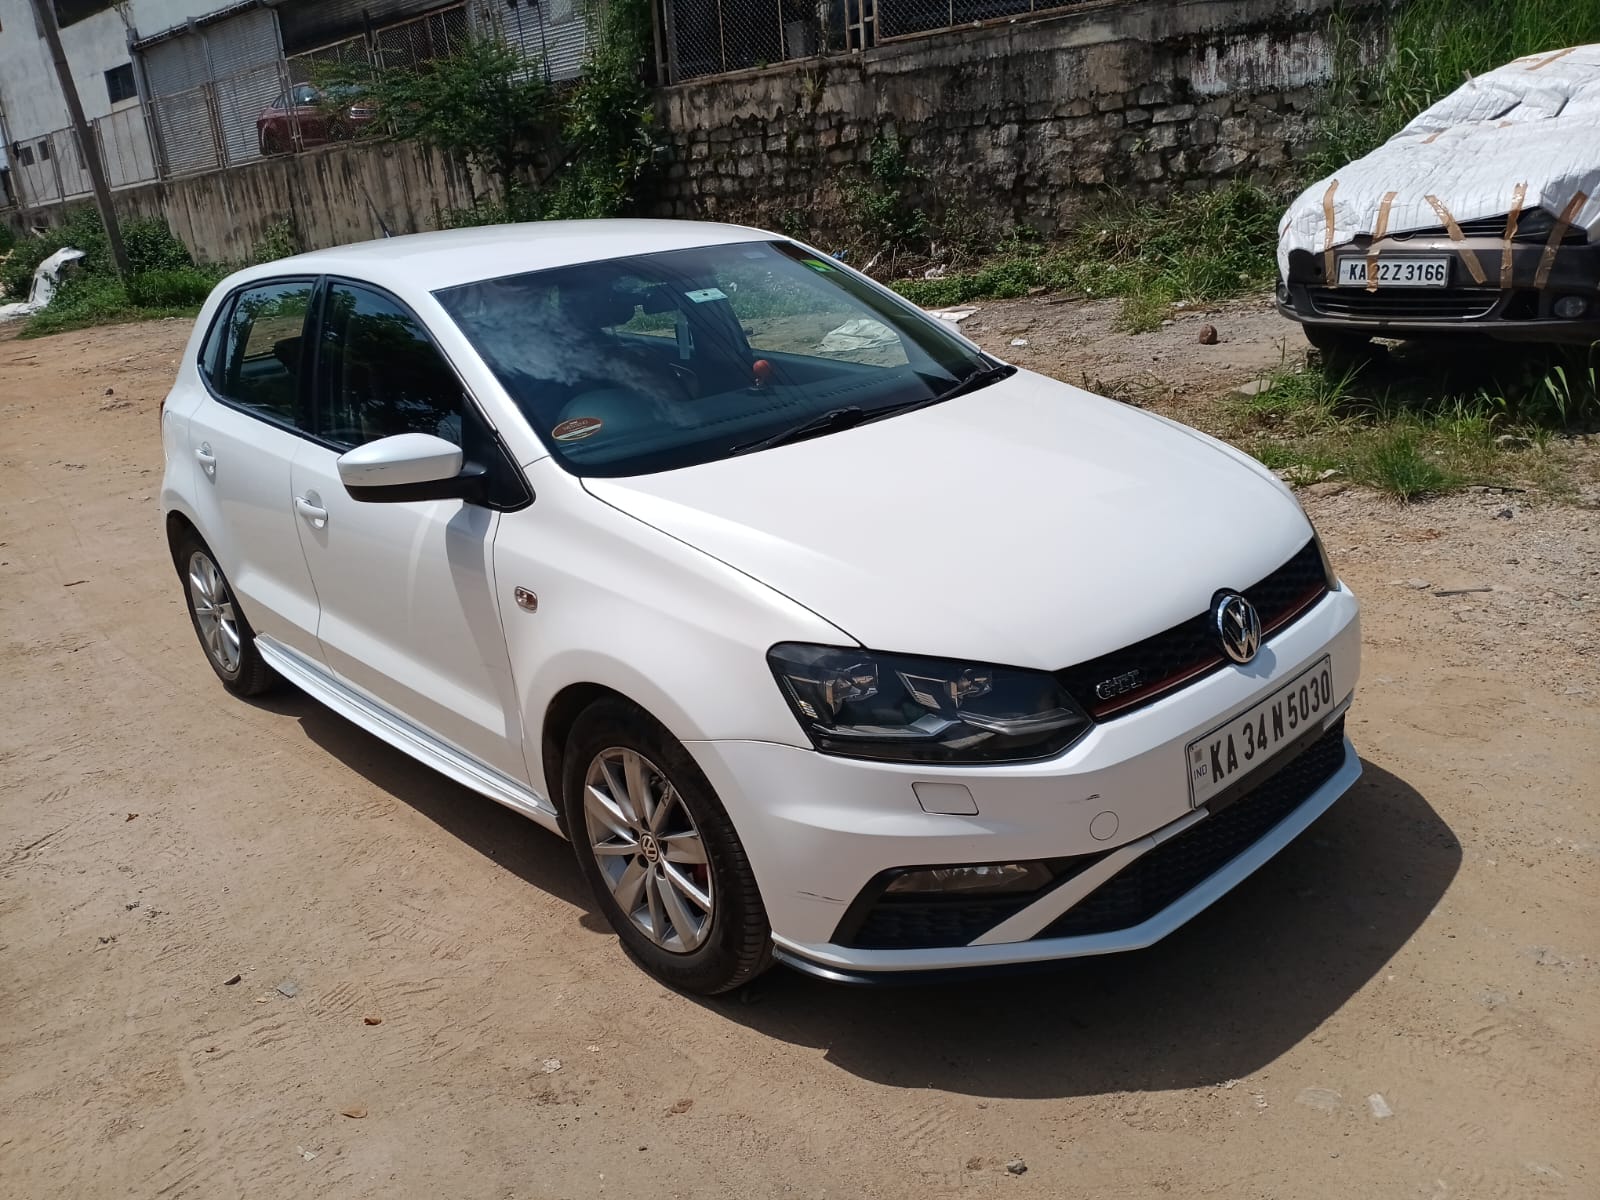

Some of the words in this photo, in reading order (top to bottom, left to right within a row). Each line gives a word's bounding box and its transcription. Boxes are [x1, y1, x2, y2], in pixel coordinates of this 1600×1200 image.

[1349, 264, 1367, 280] KA
[1392, 264, 1402, 281] Z
[1405, 264, 1445, 281] 3166
[1210, 733, 1238, 784] KA
[1243, 713, 1268, 760] 34
[1272, 701, 1284, 742] N
[1287, 669, 1330, 729] 5030
[1193, 764, 1207, 782] IND
